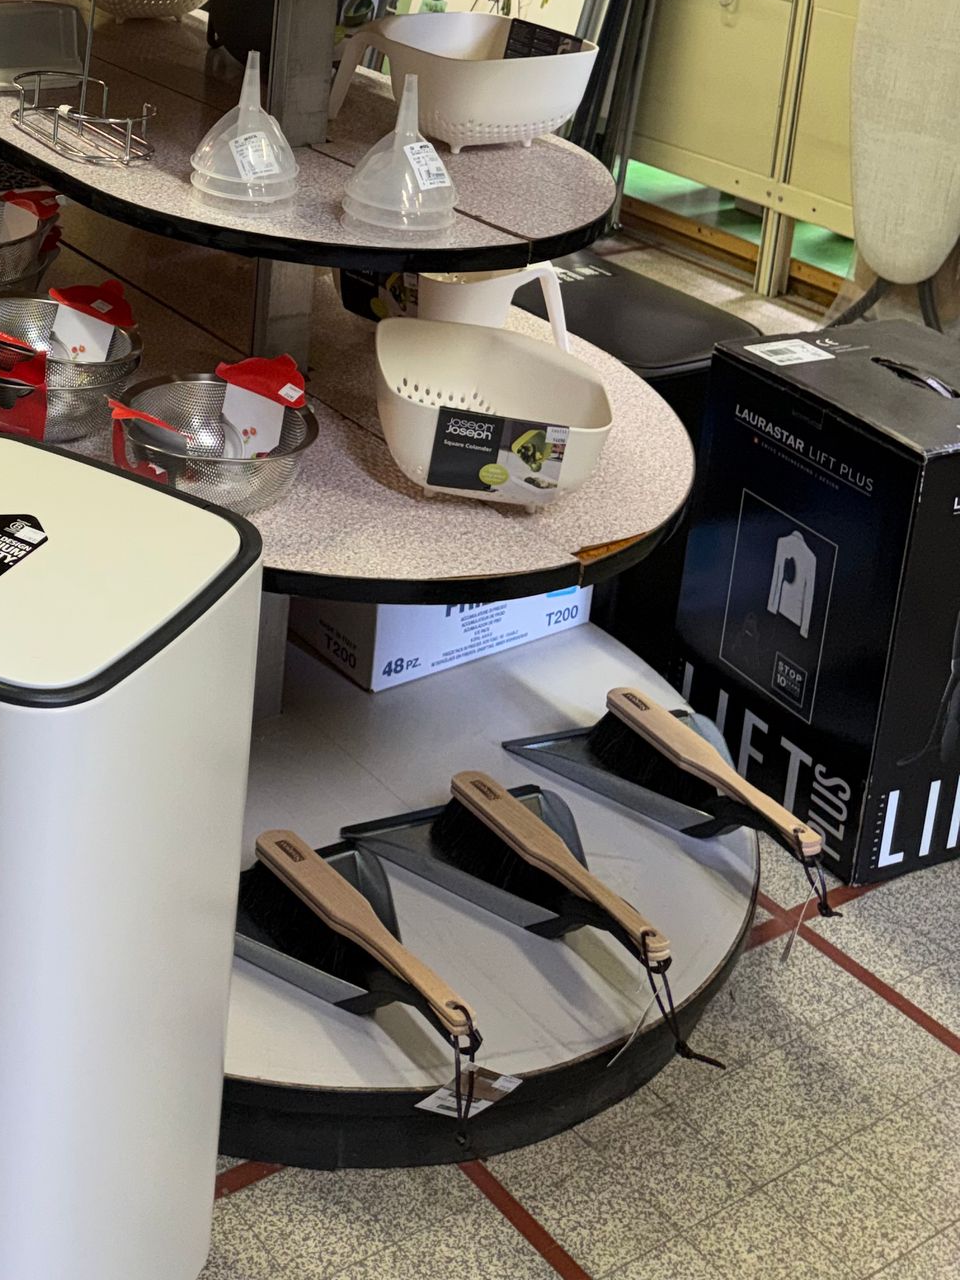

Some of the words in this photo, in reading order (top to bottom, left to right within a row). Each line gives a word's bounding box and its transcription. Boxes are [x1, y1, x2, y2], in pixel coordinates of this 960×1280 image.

[445, 425, 492, 441] Joseph
[735, 404, 805, 452] LAURASTAR
[809, 446, 837, 470] LIFT
[840, 463, 874, 492] PLUS
[0, 535, 33, 552] DESIGN
[546, 605, 579, 627] T200
[324, 633, 357, 669] T200
[382, 656, 404, 677] 48
[406, 657, 422, 670] PZ.
[778, 661, 803, 682] STOP
[777, 673, 786, 687] 10
